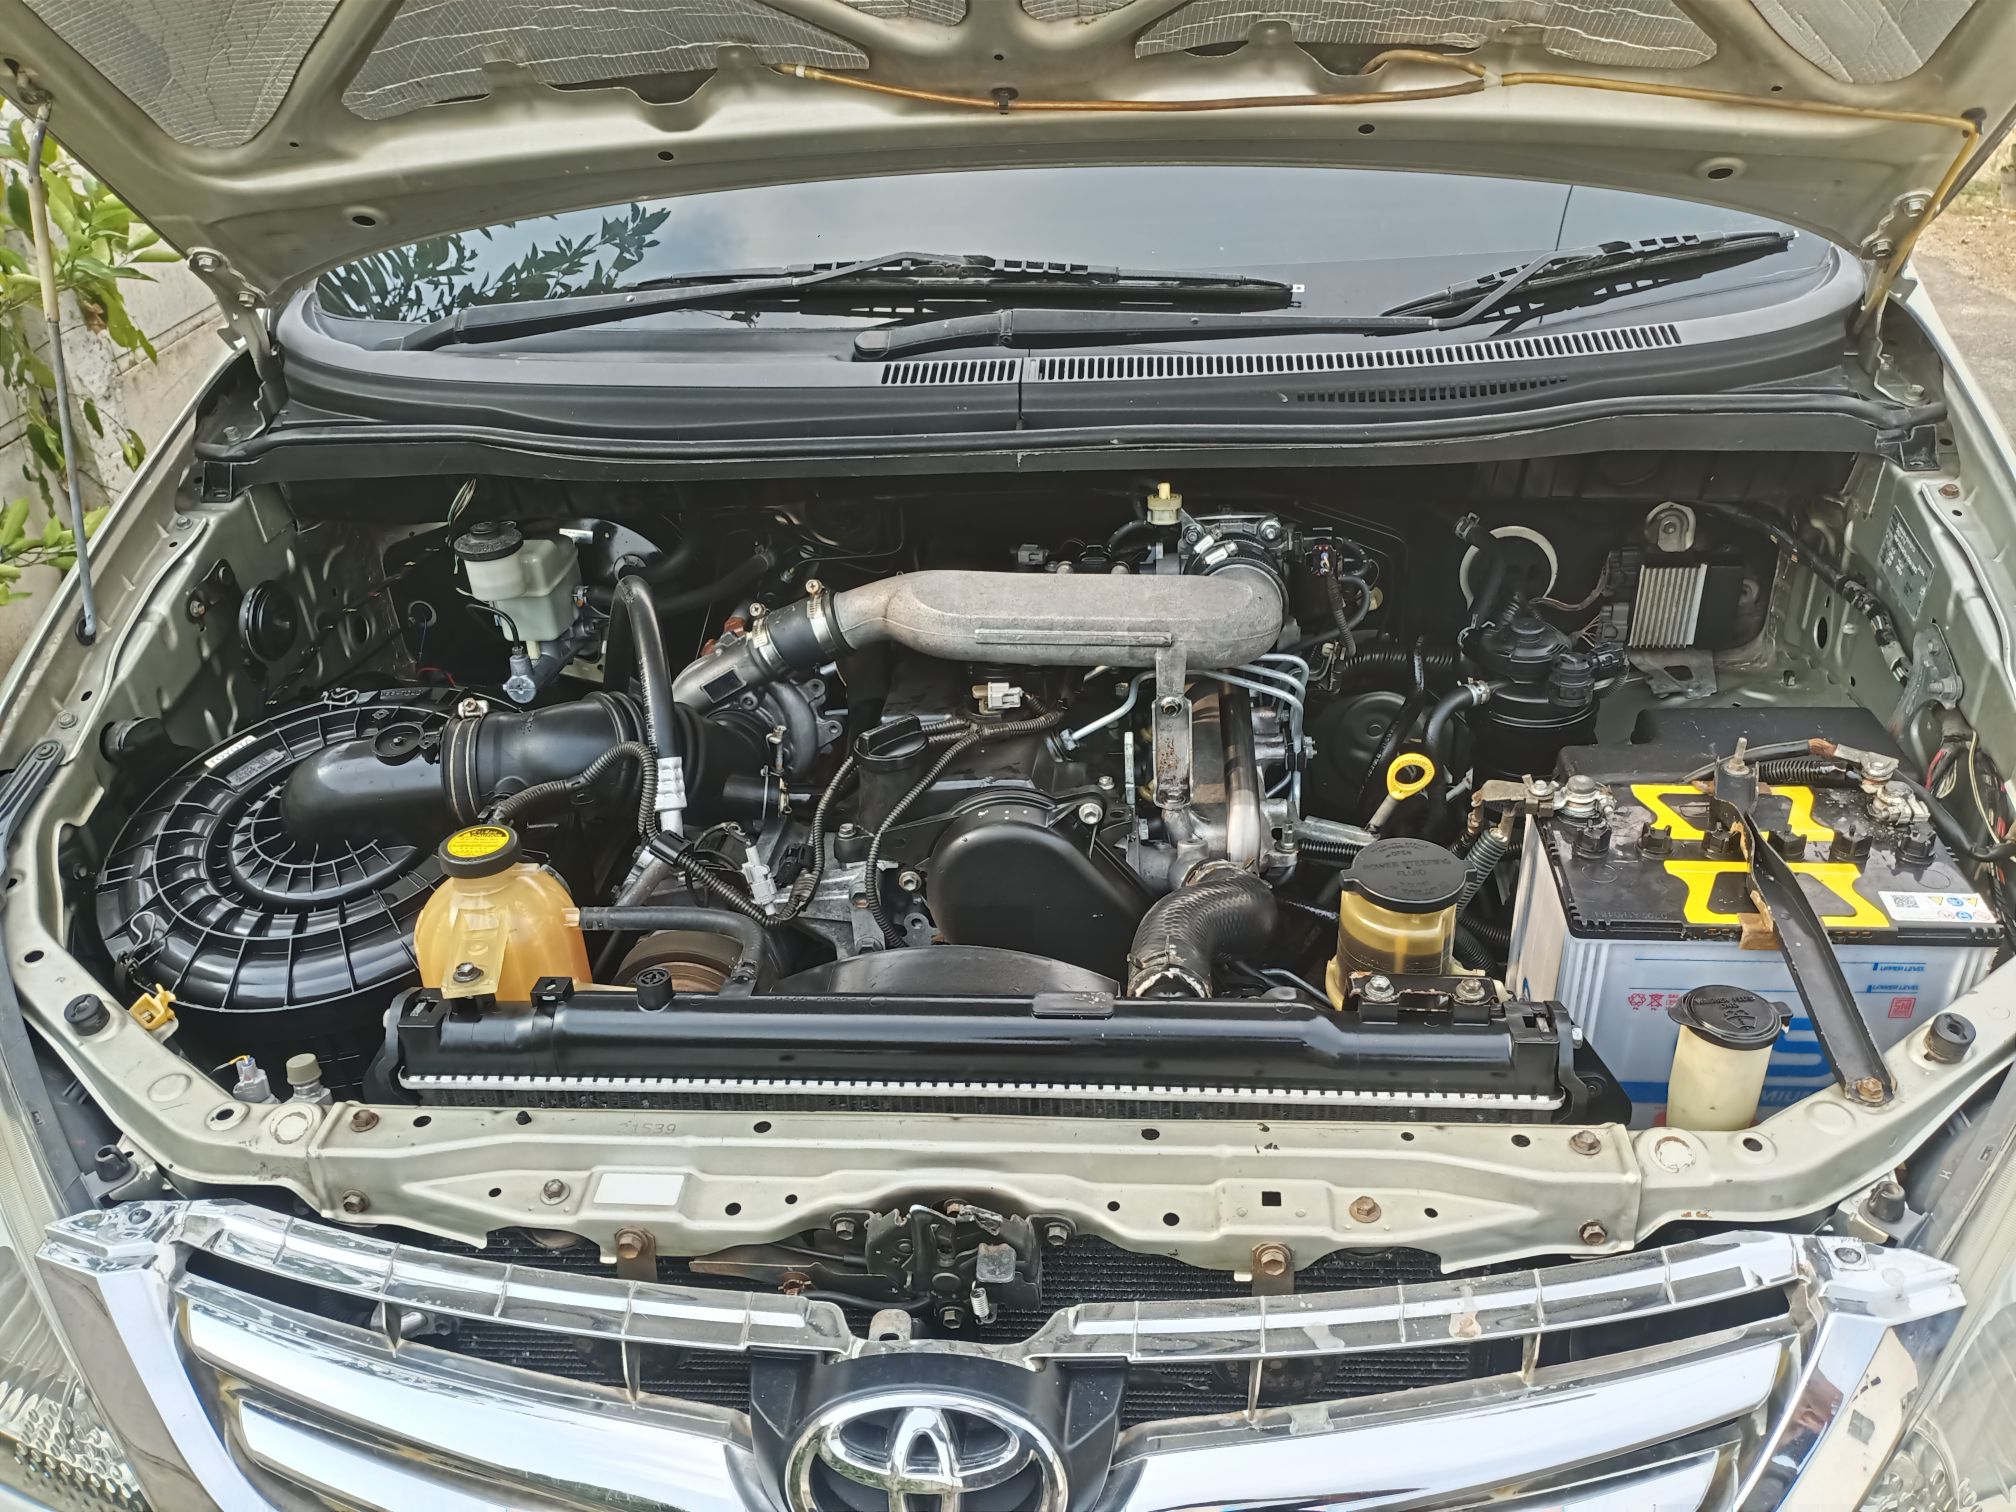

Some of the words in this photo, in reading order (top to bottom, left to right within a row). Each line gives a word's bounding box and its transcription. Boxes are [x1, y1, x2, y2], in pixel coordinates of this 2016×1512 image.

[211, 737, 254, 765] TOYOTA
[1362, 861, 1401, 871] POWER
[1396, 869, 1427, 877] FLUID
